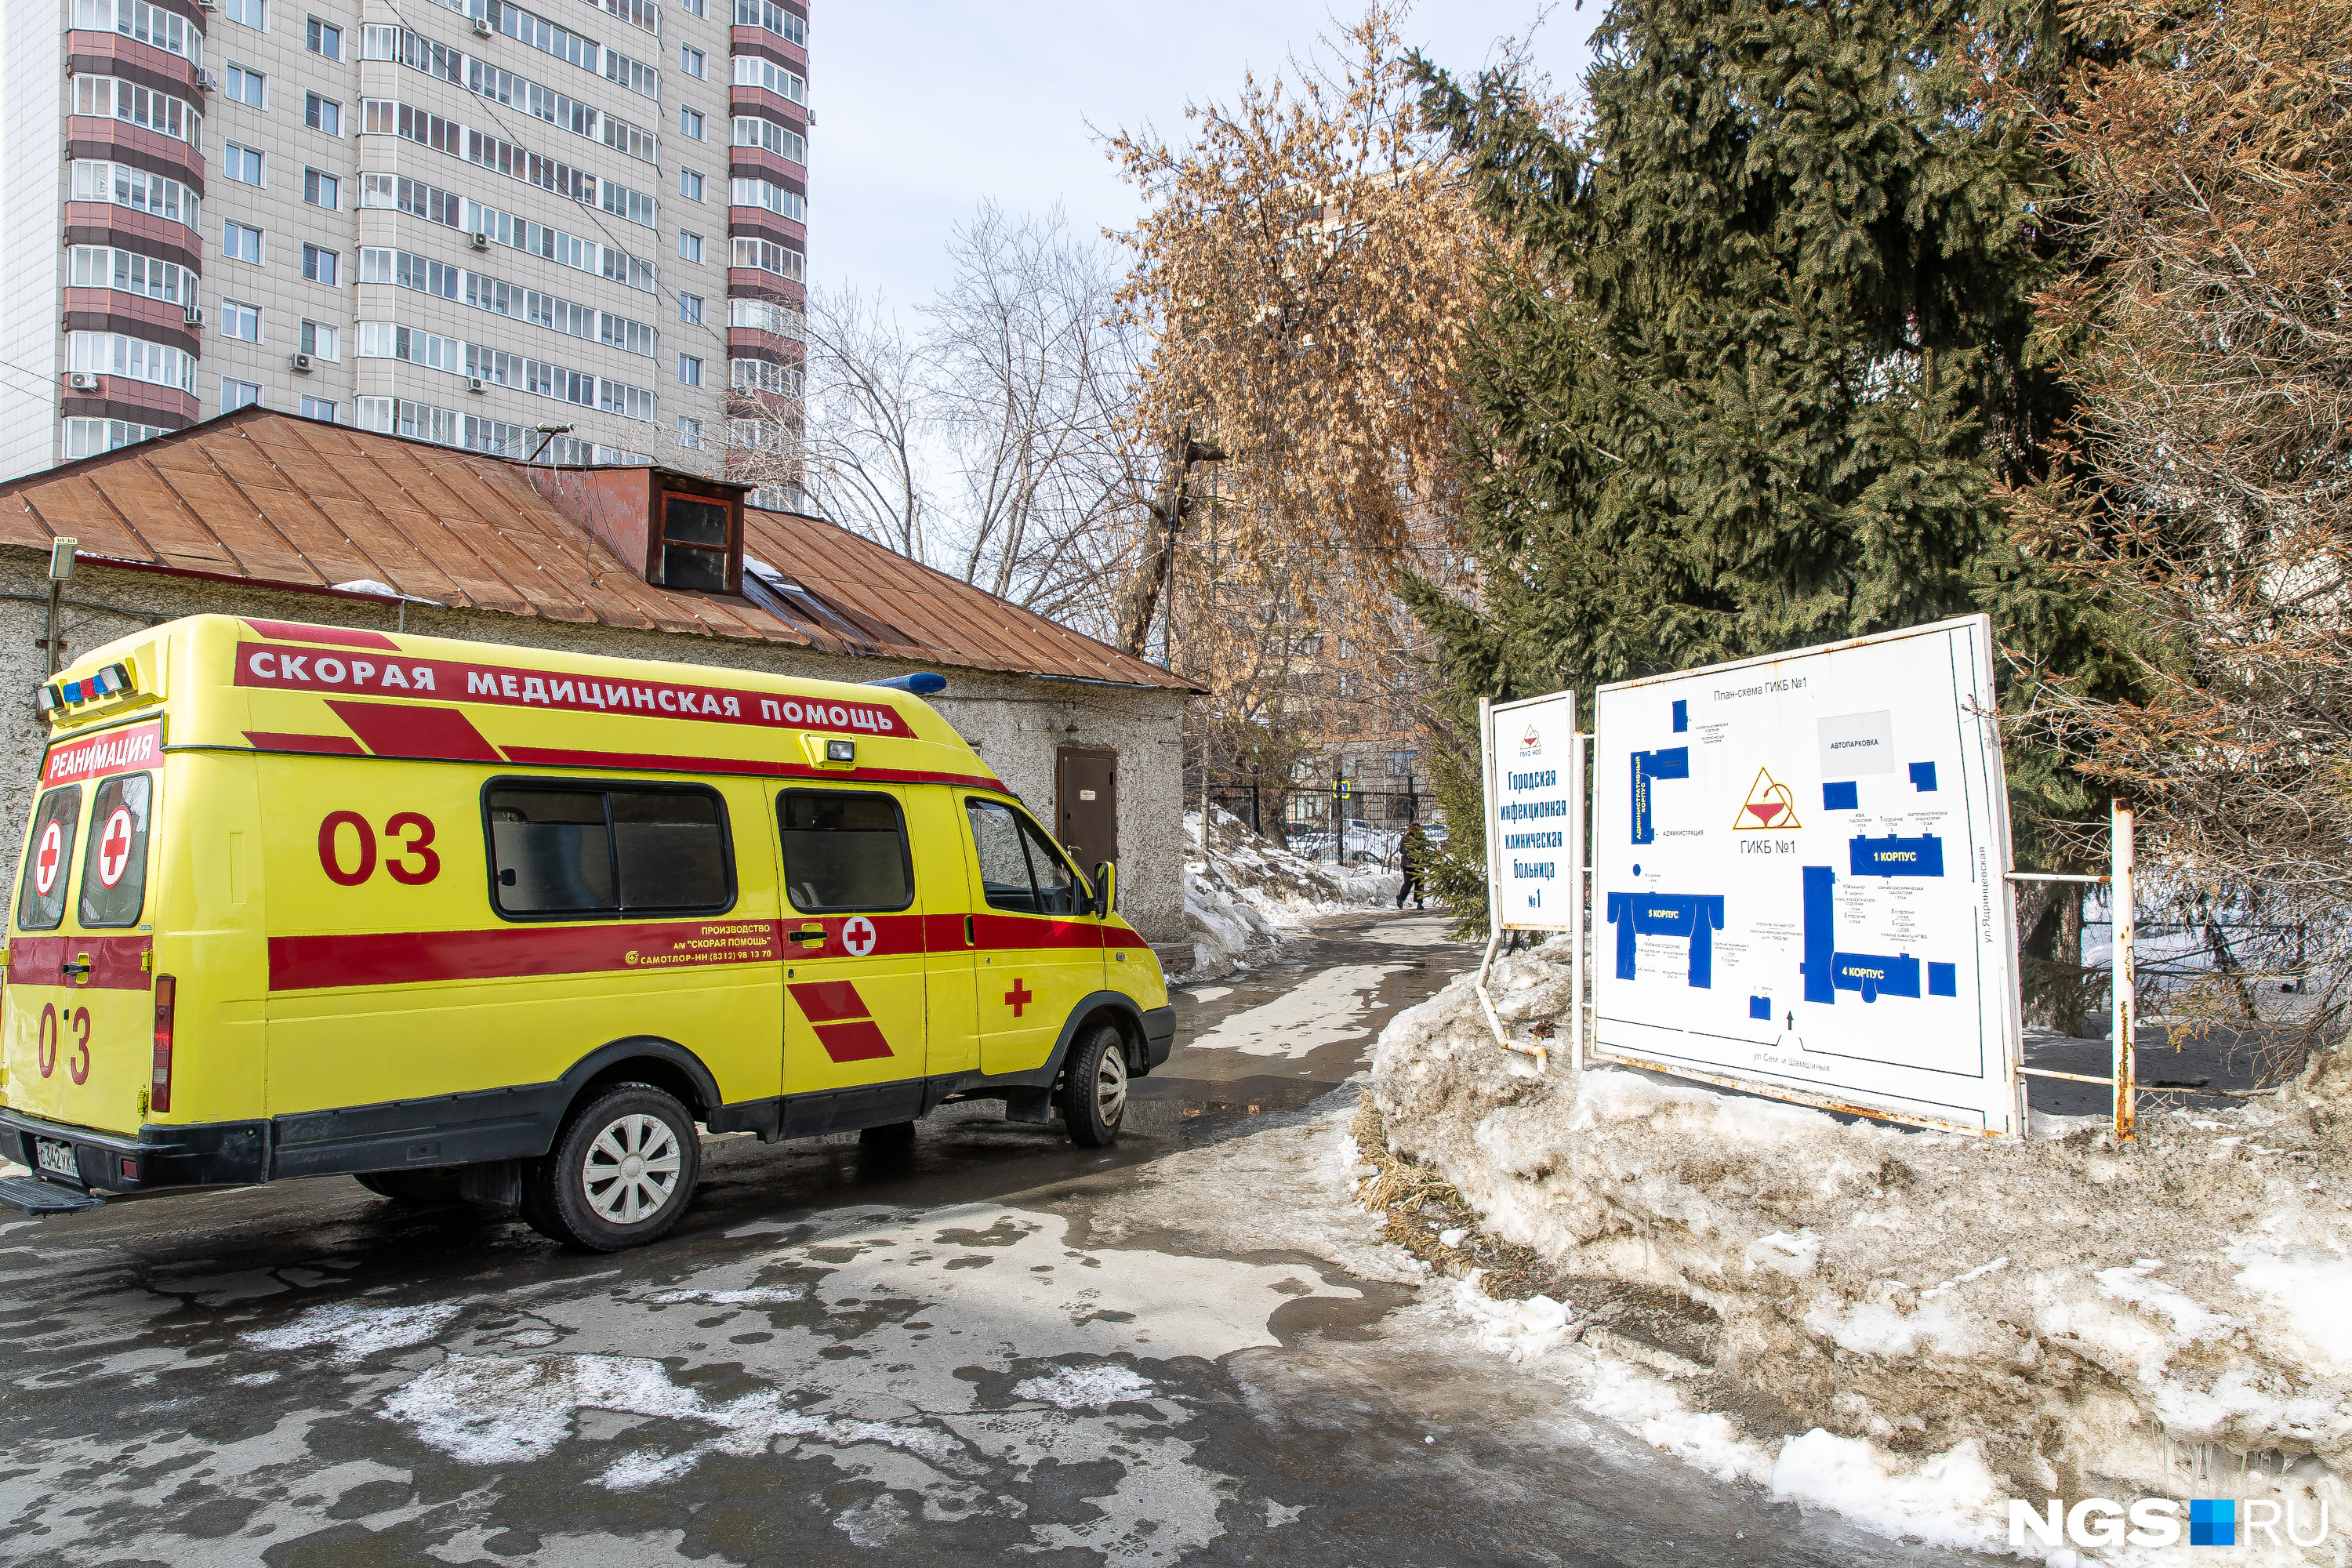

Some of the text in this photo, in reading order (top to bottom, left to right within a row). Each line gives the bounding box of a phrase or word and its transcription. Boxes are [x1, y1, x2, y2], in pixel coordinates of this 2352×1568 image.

[249, 652, 895, 734] СКОРАЯ МЕДИЦИНСКАЯ ПОМОЩЬ
[1714, 677, 1807, 702] План-схема ГИКБ №1
[1831, 739, 1879, 750] АВТОПАРКОВКА
[49, 732, 154, 780] РЕАНИМАЦИЯ
[1508, 769, 1556, 794] Городская
[1501, 800, 1566, 824] инфекционная
[318, 810, 441, 887] 03
[1505, 832, 1563, 849] клиническая
[1740, 840, 1795, 854] ГИКБ №1
[1873, 851, 1917, 862] 1 КОРПУС
[1514, 858, 1555, 881] больница
[1648, 909, 1679, 920] 5 КОРПУС
[701, 924, 771, 935] ПРОИЗВОДСТВО
[687, 938, 727, 949] "СКОРАЯ
[728, 936, 771, 947] ПОМОЩЬ"
[640, 954, 708, 964] САМОТЛОР-НН
[710, 951, 735, 962] (8312)
[1842, 966, 1885, 979] 4 КОРПУС
[39, 1002, 91, 1086] 03
